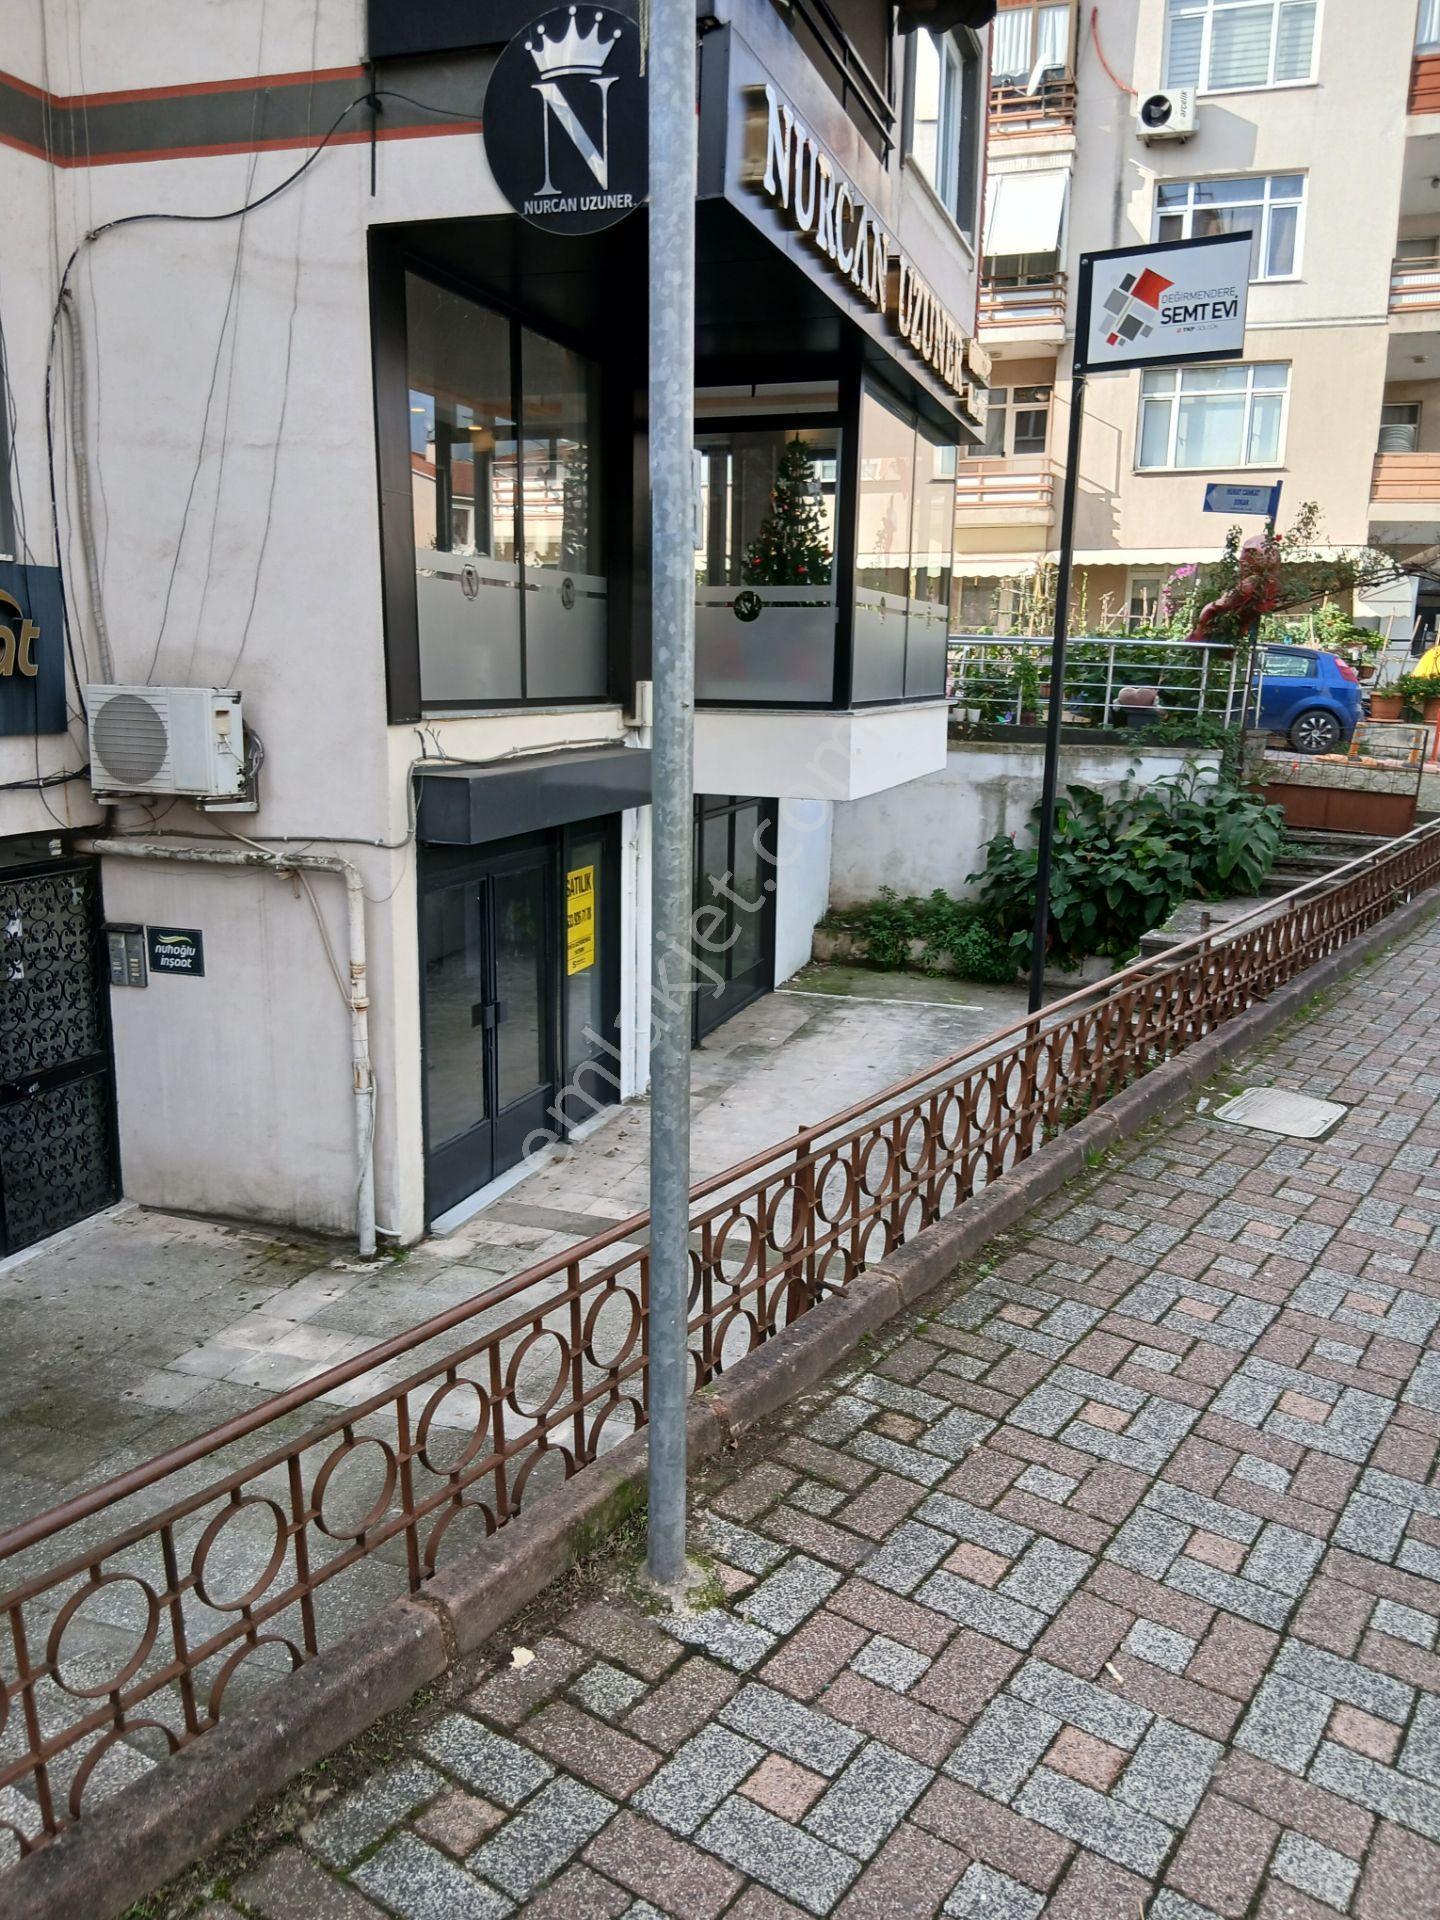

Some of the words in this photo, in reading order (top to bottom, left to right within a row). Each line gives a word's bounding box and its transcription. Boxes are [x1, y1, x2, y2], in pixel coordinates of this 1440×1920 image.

[531, 77, 620, 196] N
[523, 197, 577, 215] NURCAN
[580, 194, 633, 211] UZUNER
[763, 84, 890, 313] NURCAN
[899, 255, 963, 396] UZUNER
[1160, 303, 1210, 325] SEMT
[155, 944, 196, 958] nuhoğlu
[160, 955, 192, 968] inşaat
